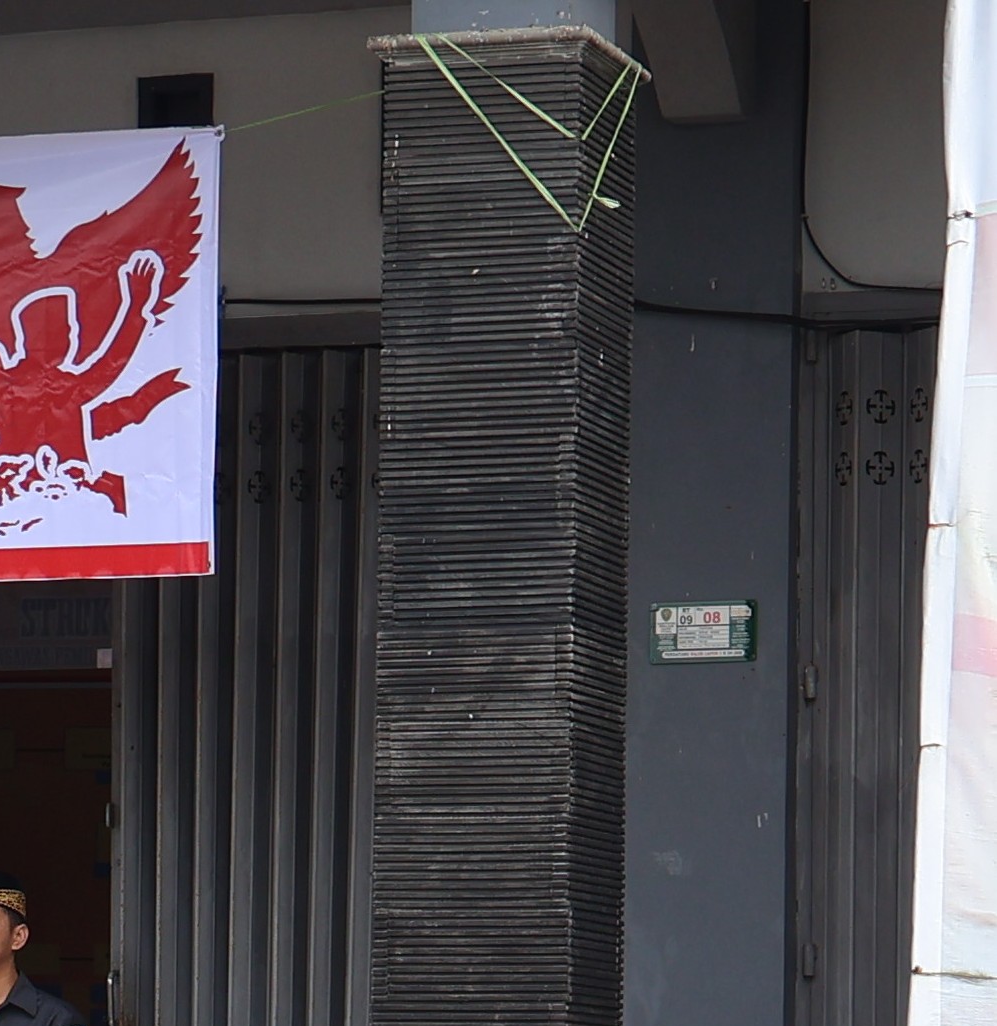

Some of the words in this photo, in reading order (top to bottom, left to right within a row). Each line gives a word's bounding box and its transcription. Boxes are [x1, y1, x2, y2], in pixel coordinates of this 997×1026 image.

[21, 597, 111, 637] STRUK
[679, 614, 693, 625] 09
[703, 611, 721, 624] 08
